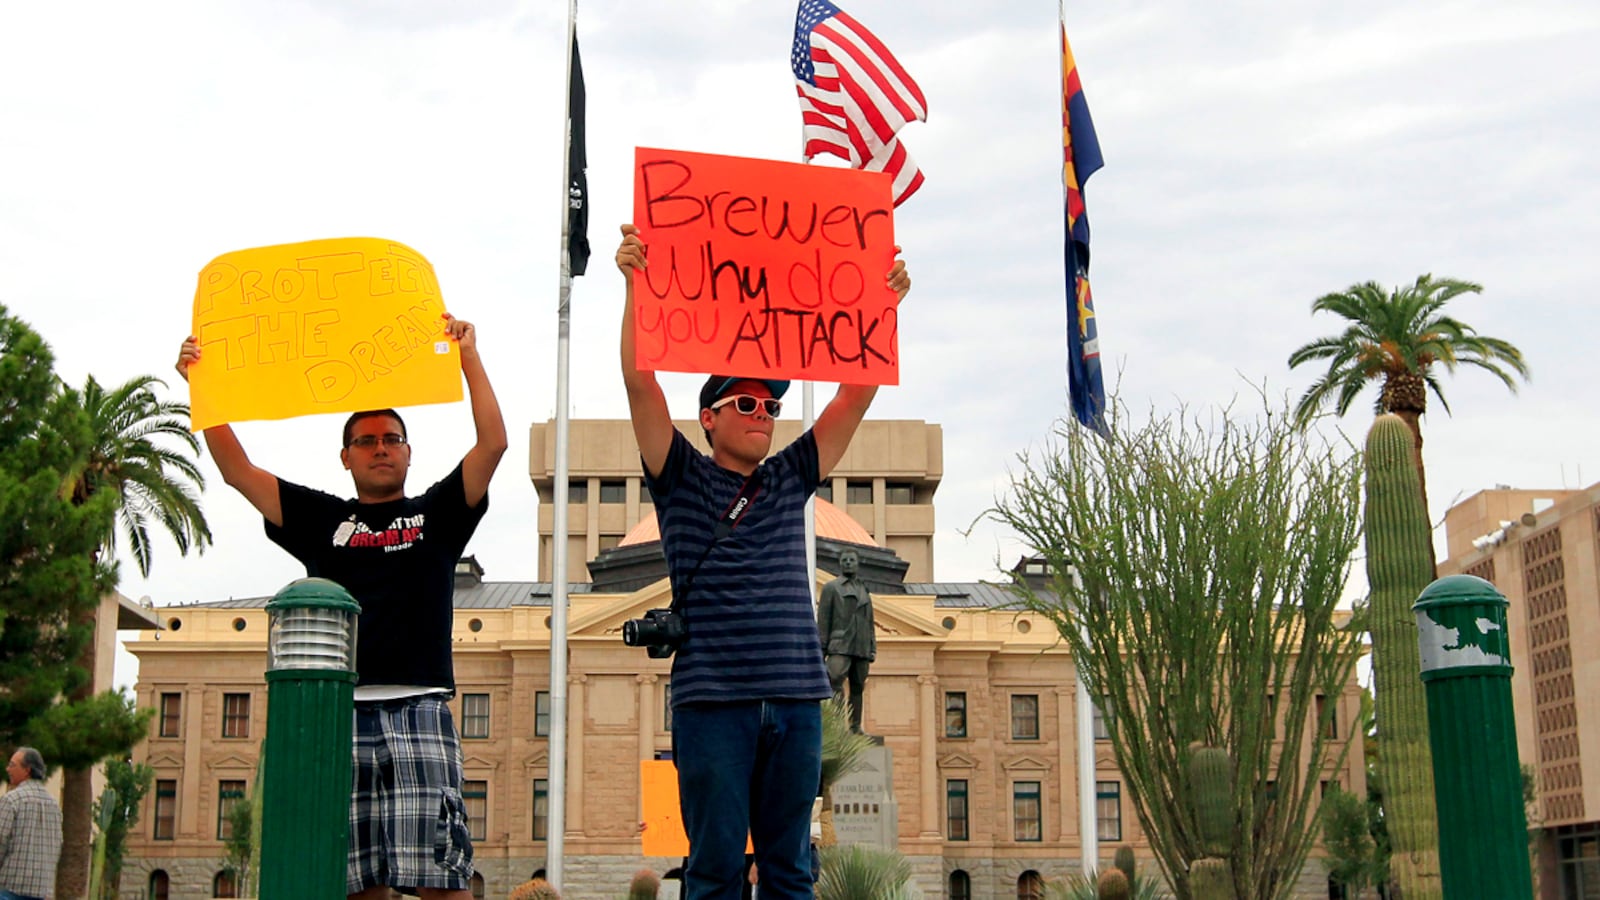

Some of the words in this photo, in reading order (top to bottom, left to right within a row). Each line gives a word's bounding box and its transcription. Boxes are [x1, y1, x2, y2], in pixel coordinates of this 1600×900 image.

[641, 160, 888, 250] Brewer
[198, 244, 435, 317] PROTECT
[644, 240, 770, 322] Why
[788, 249, 864, 308] do
[200, 308, 341, 371] THE
[304, 299, 447, 403] DREAM
[726, 307, 898, 368] ATTACK?
[729, 496, 748, 520] Canon
